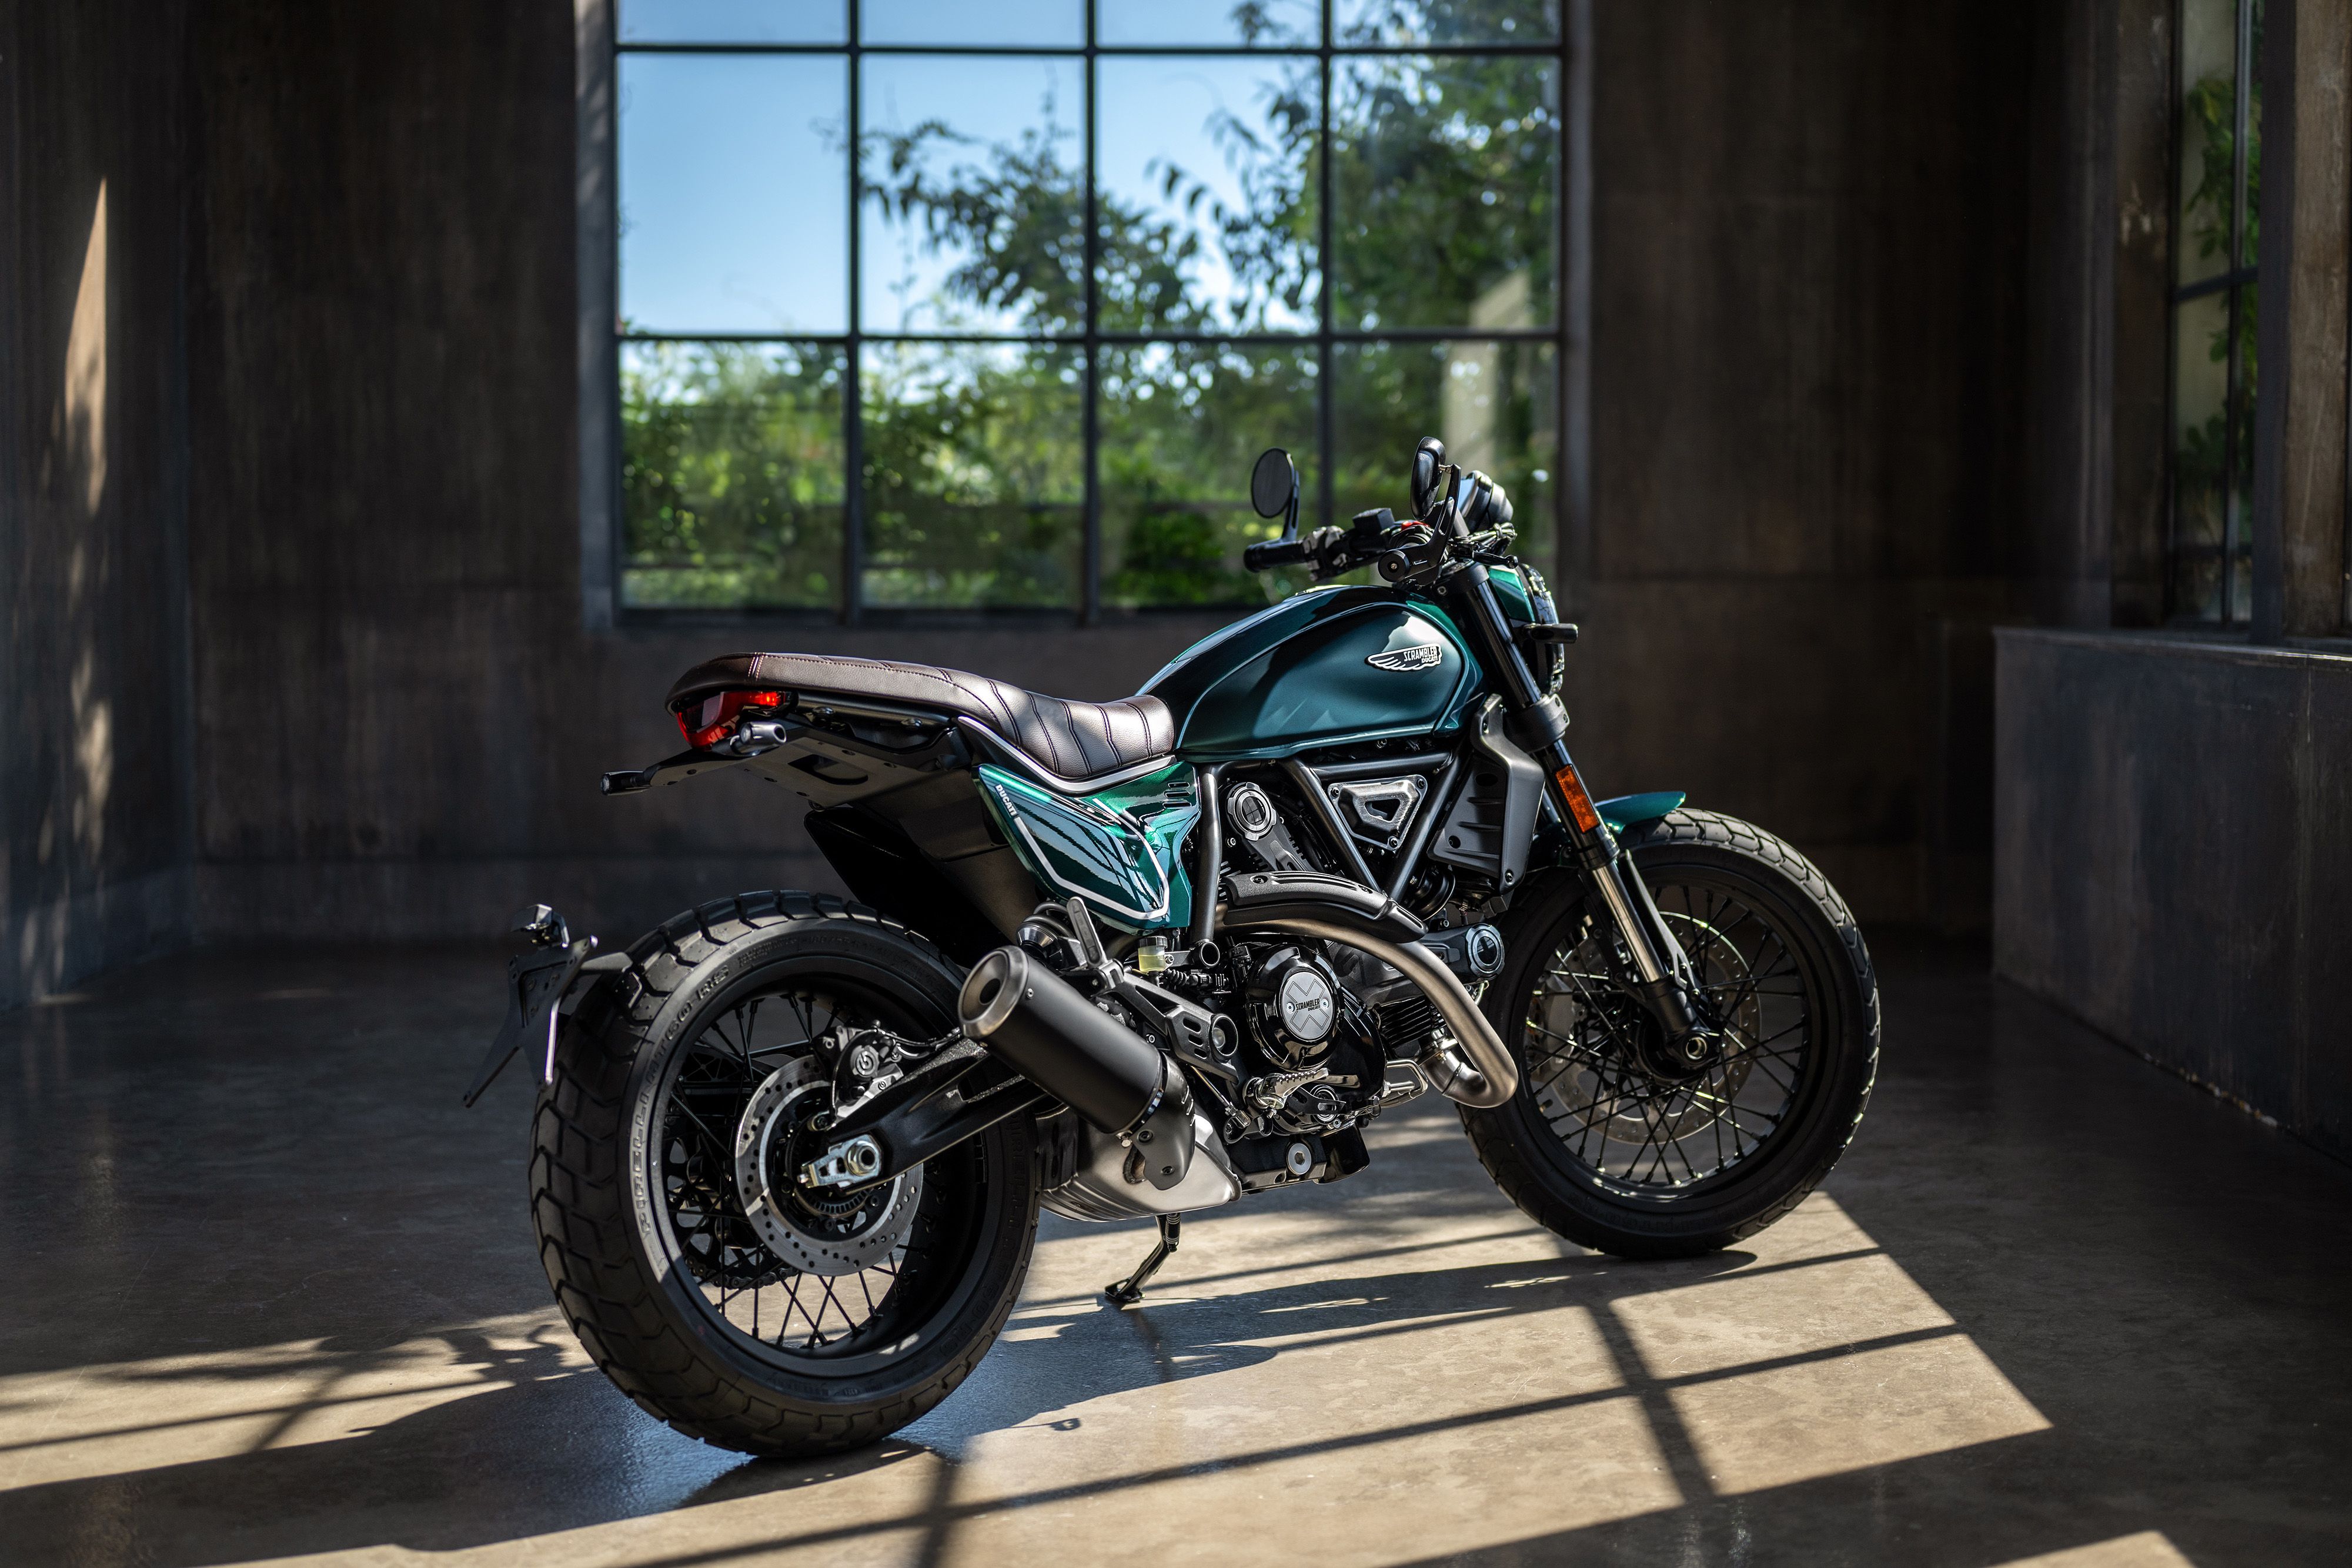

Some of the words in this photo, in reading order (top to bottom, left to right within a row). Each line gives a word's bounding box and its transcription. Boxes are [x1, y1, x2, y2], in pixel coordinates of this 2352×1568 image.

[1404, 646, 1438, 662] SCRAMBLER
[1421, 655, 1438, 663] DUCATI
[995, 784, 1017, 816] DUCATI
[1295, 998, 1320, 1011] SCRAMBLER
[632, 1093, 651, 1233] PIRELLI
